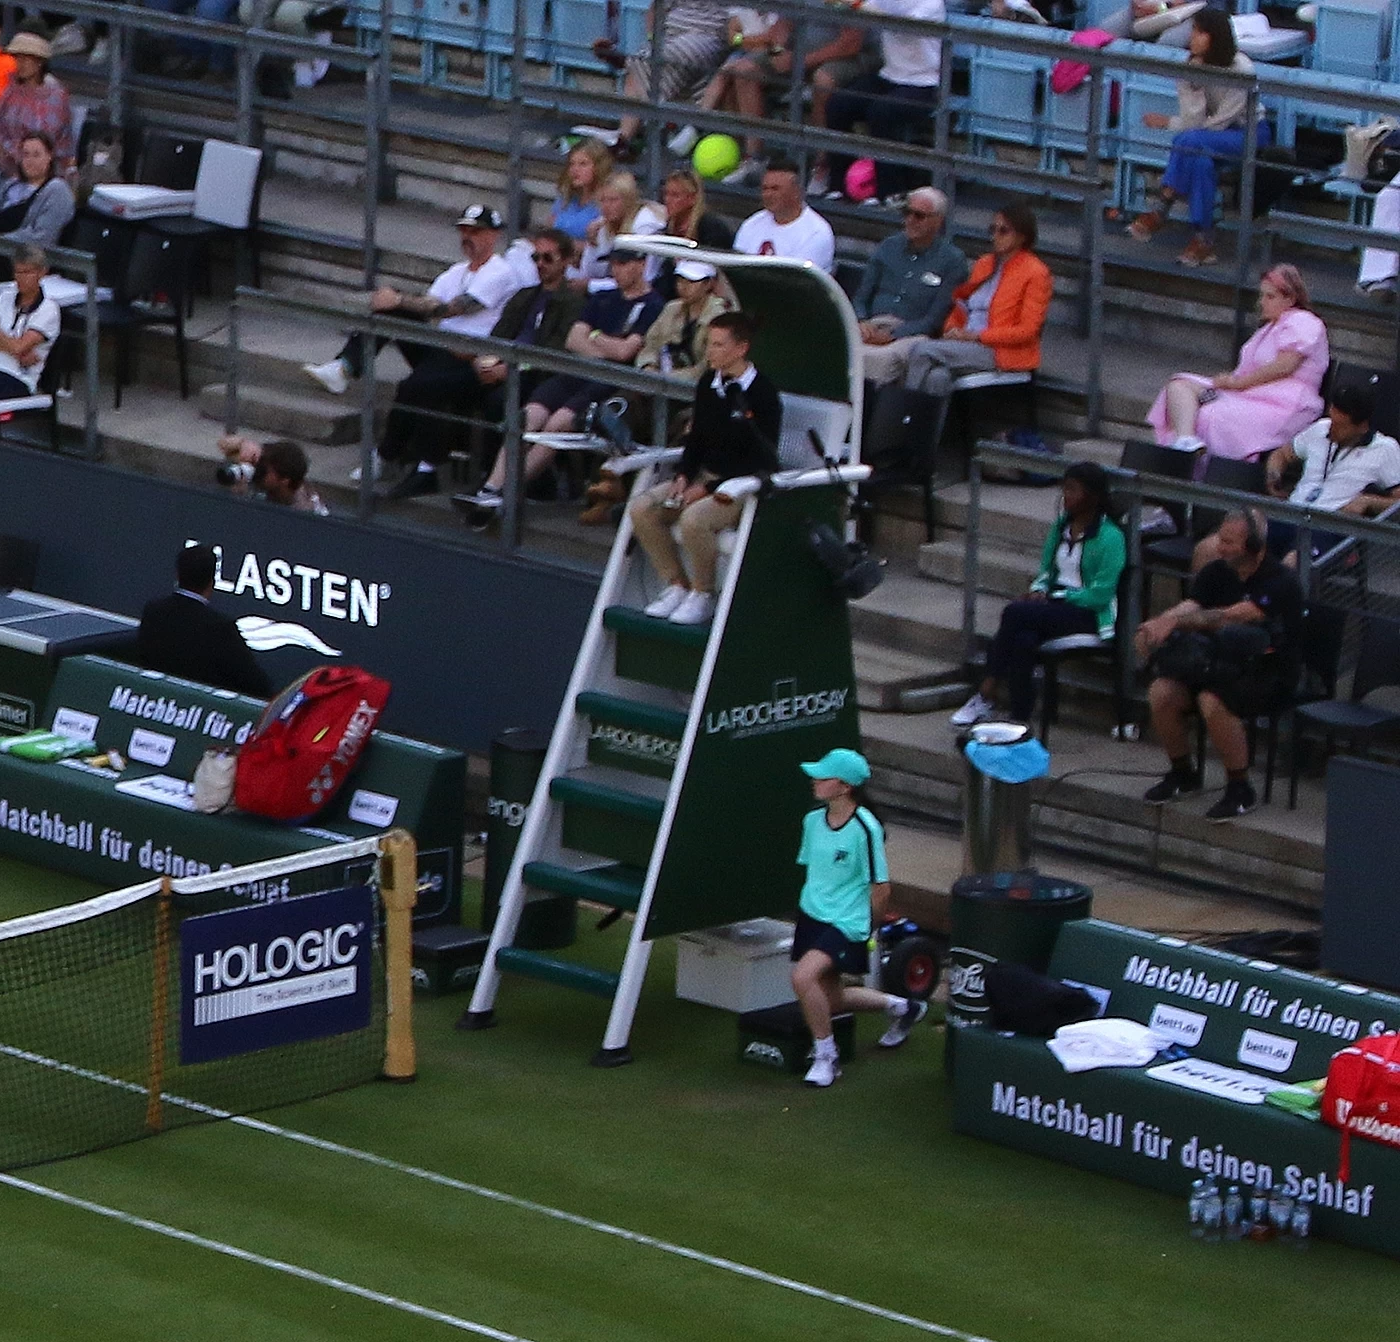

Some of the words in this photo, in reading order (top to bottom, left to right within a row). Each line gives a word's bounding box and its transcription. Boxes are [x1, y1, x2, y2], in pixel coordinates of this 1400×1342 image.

[109, 685, 203, 731] Matchball
[202, 710, 234, 741] für
[100, 827, 133, 862] für
[1123, 955, 1240, 1008] Matchball
[1240, 985, 1279, 1019] für
[1280, 997, 1361, 1041] deinen
[991, 1081, 1124, 1147] Matchball
[1131, 1121, 1173, 1161] für
[1180, 1136, 1273, 1189] deinen
[1283, 1164, 1374, 1218] Schlaf
